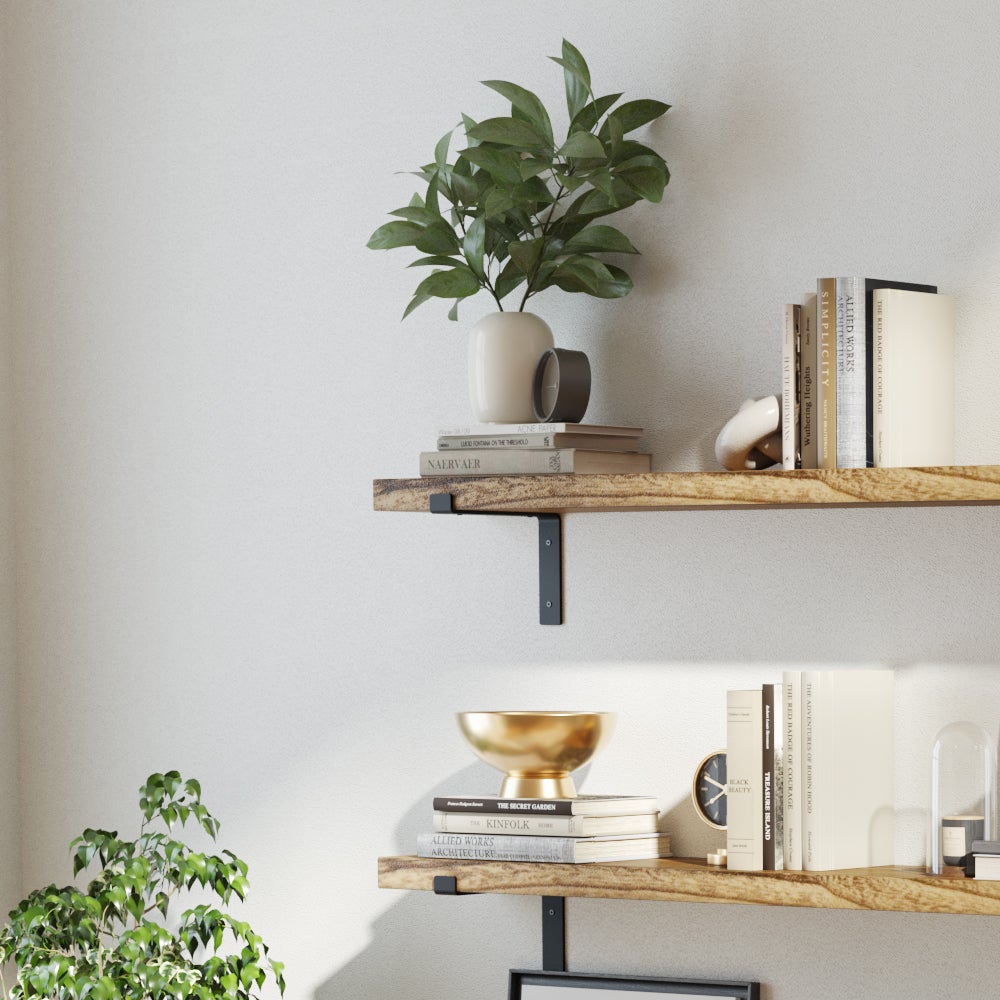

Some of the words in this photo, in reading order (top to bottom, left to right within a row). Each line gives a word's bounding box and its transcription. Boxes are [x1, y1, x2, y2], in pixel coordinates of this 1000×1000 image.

[846, 295, 854, 333] ALLIED
[846, 336, 854, 373] WORKS
[428, 458, 481, 470] NAERVAER
[787, 754, 793, 765] OF
[807, 753, 812, 762] OF
[531, 803, 556, 811] GARDEN
[486, 818, 530, 830] KINFOLK
[431, 836, 462, 846] ALLIED
[464, 837, 495, 847] WORKS
[431, 848, 495, 859] ARCHITECTURE
